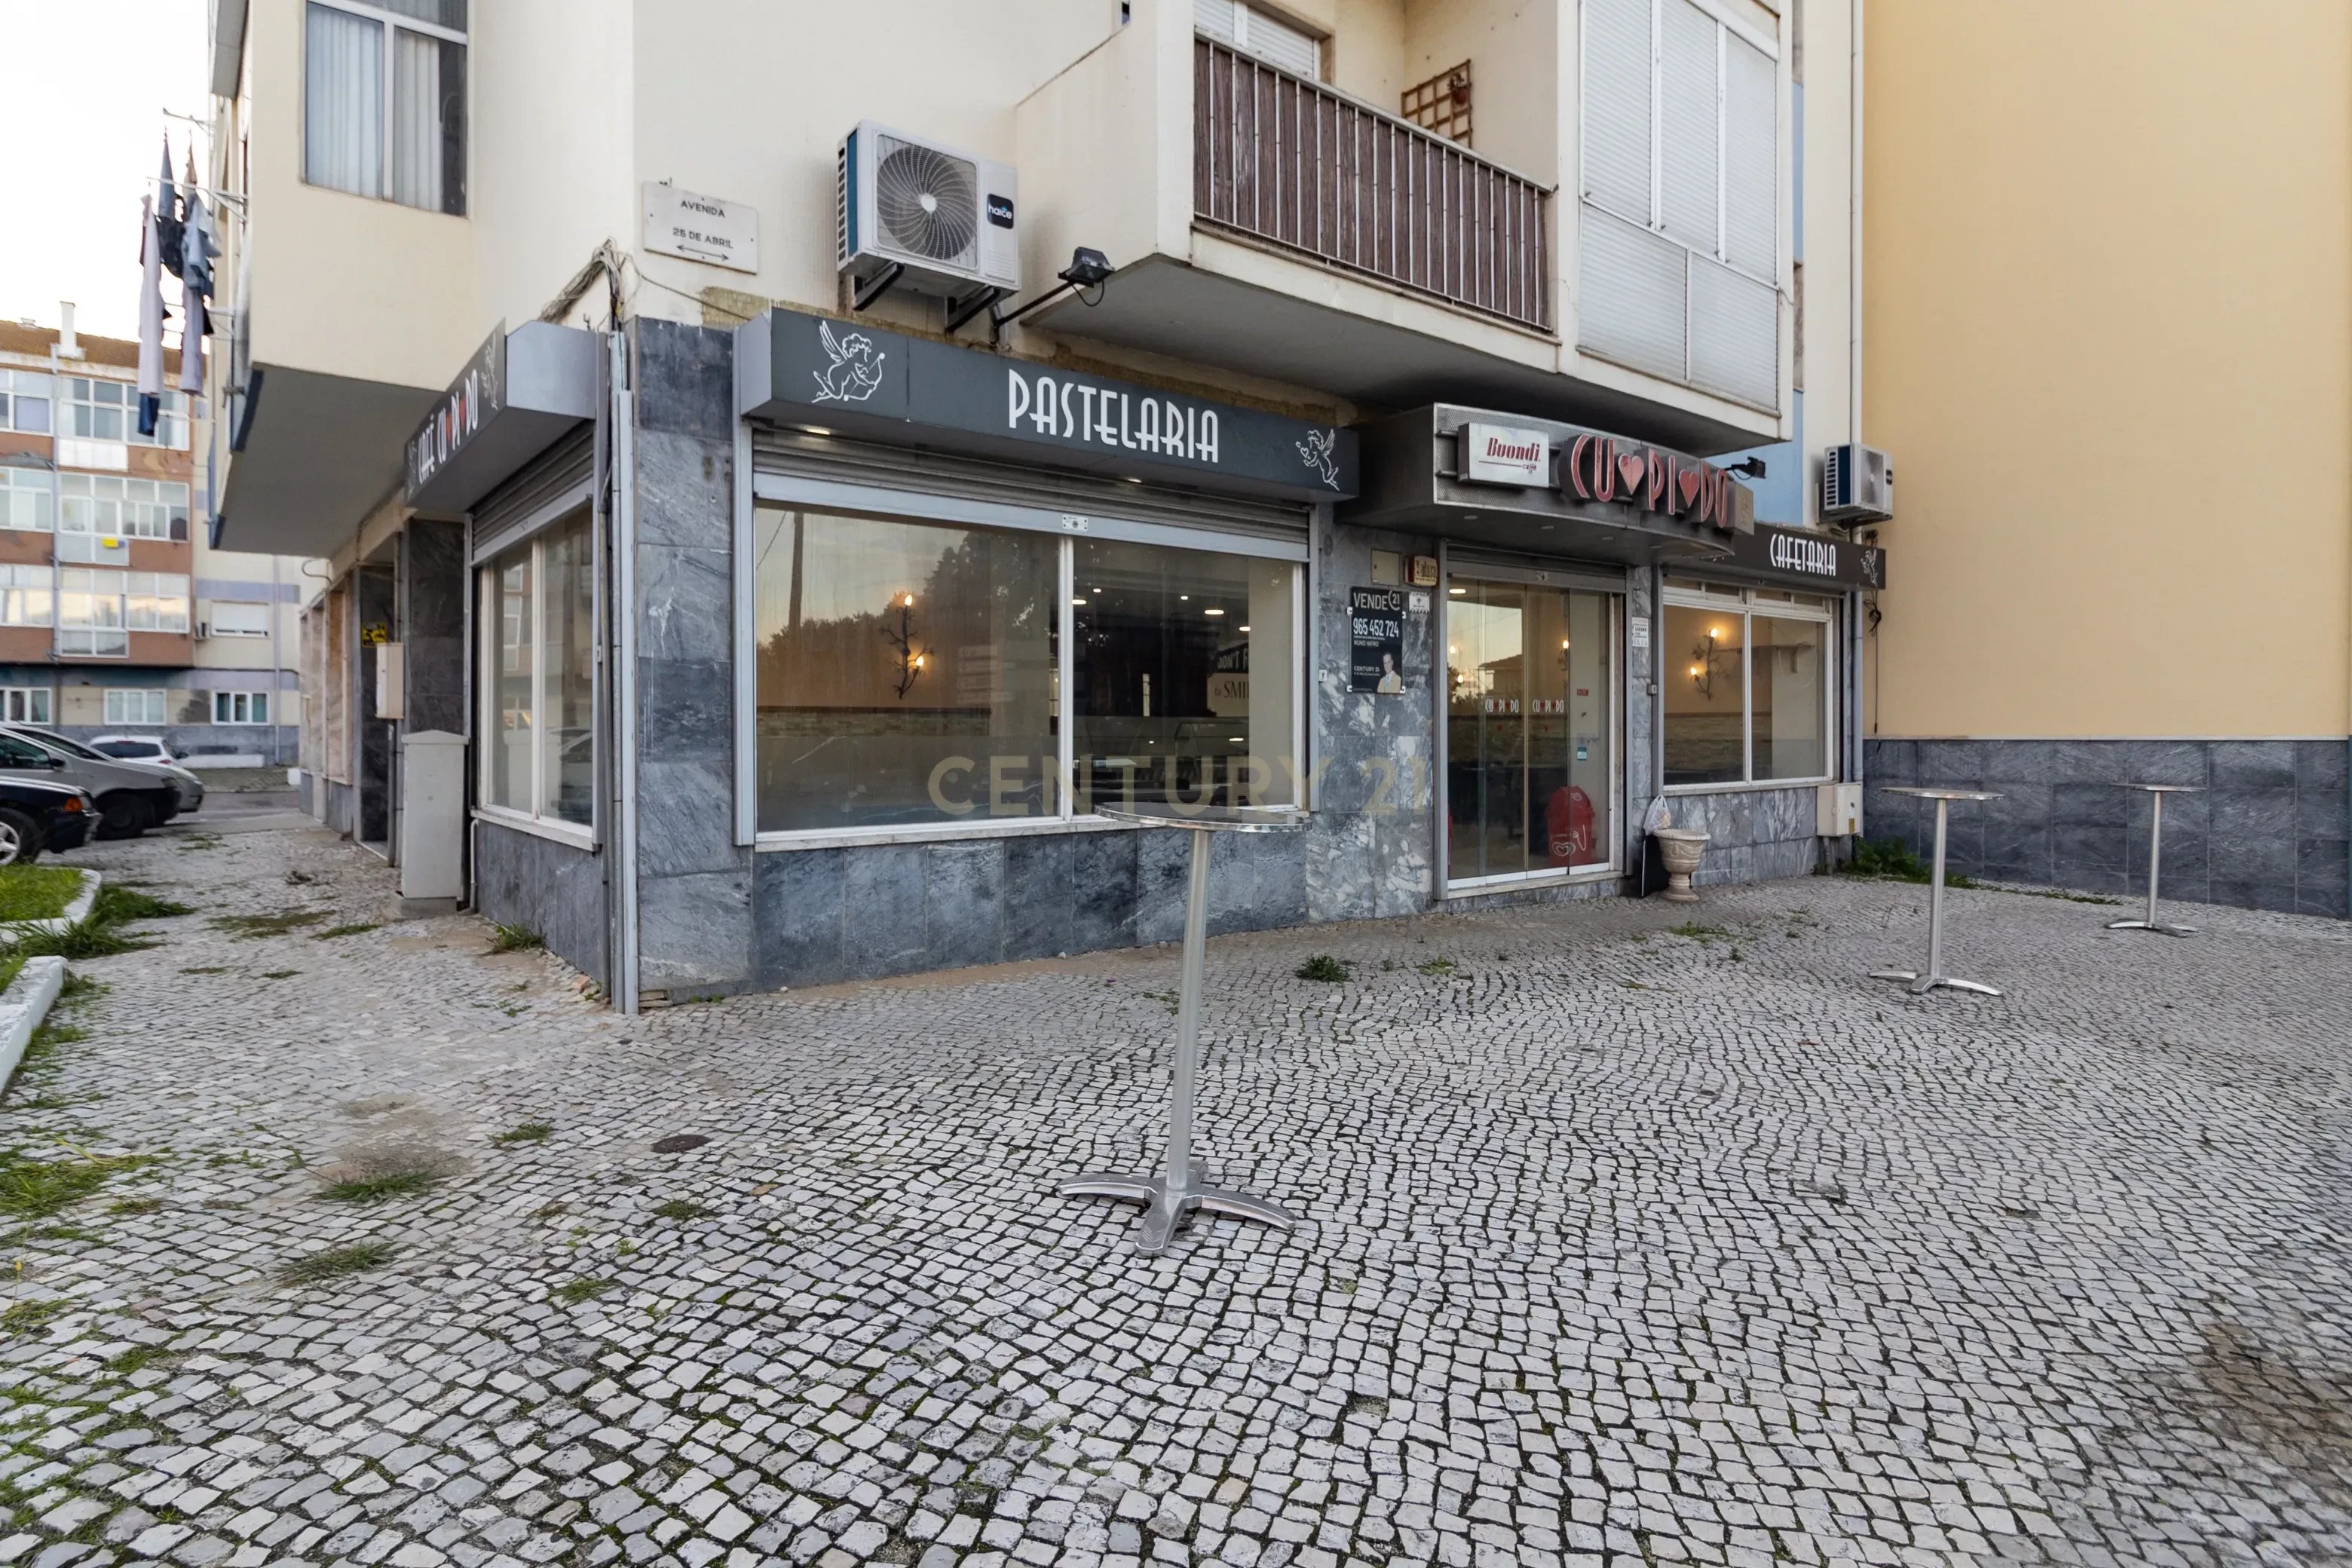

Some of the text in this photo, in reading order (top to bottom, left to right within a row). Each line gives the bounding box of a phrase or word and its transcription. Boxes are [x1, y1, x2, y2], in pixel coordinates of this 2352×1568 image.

[681, 200, 725, 219] AVENIDA
[672, 227, 733, 250] 25 DE ABRIL
[1009, 369, 1219, 464] PASTELARIA
[1769, 533, 1836, 577] CAFETARIA
[1353, 592, 1388, 611] VENDE
[1353, 617, 1399, 638] 965 452 724
